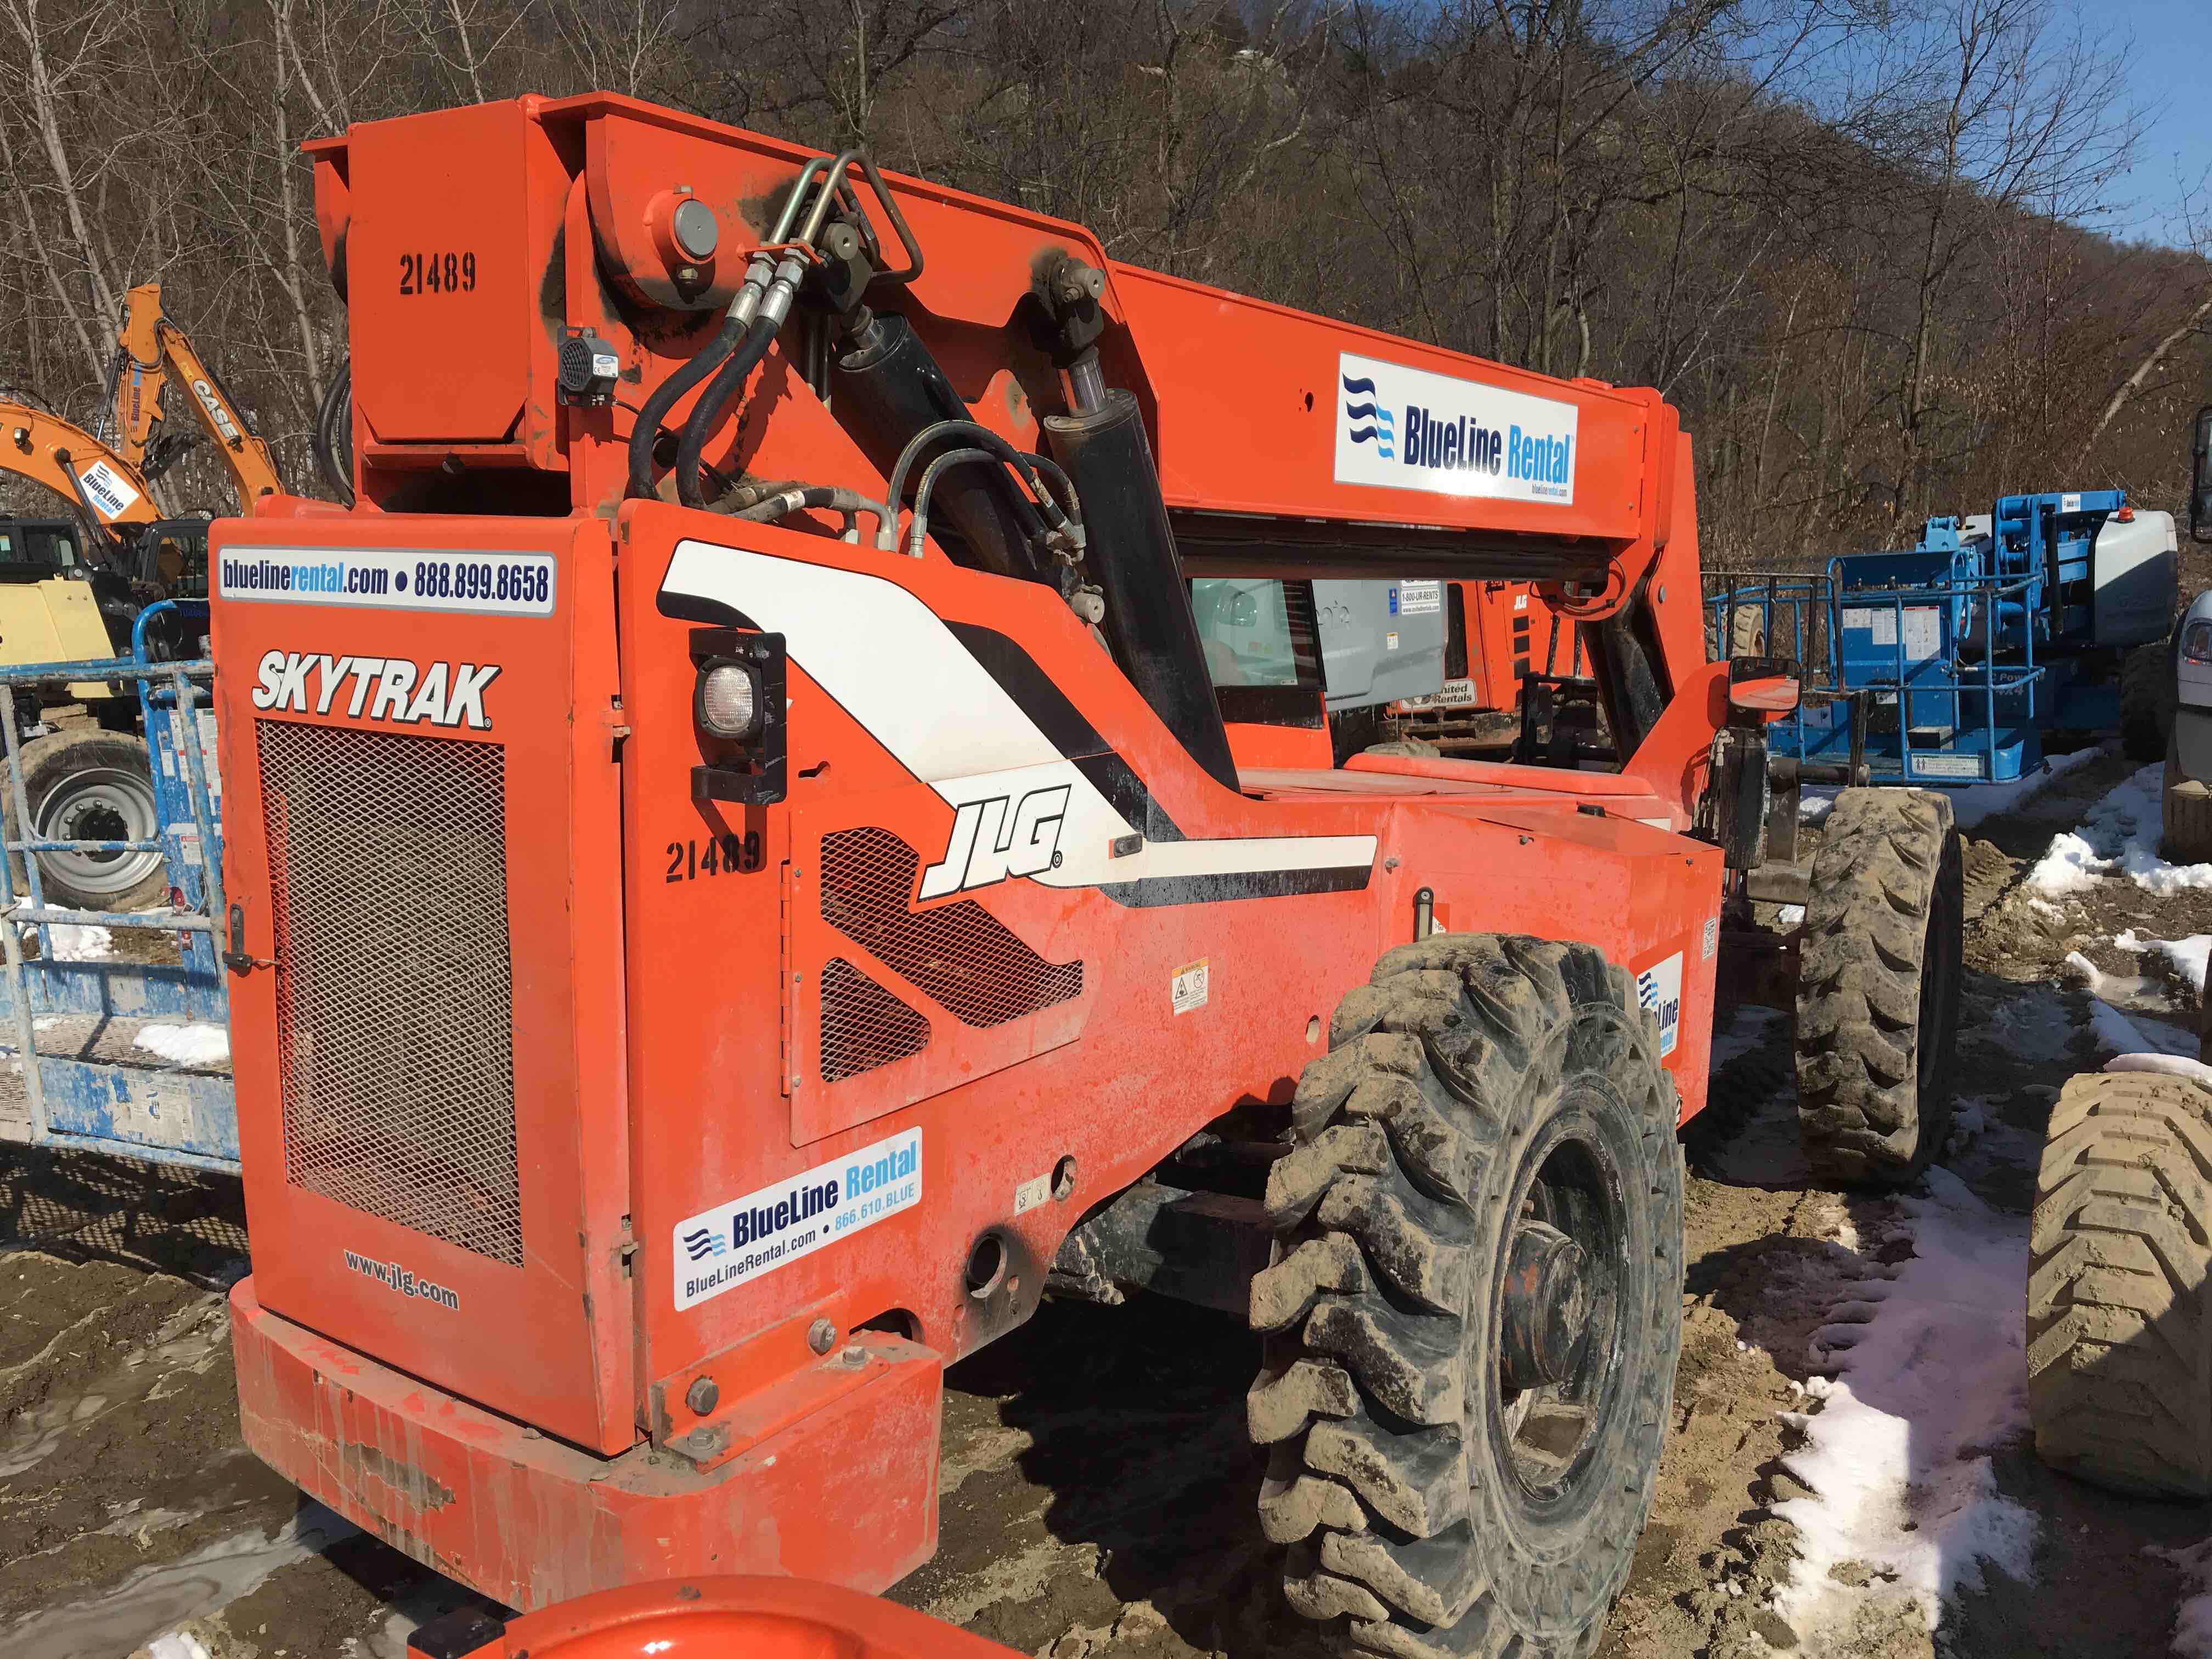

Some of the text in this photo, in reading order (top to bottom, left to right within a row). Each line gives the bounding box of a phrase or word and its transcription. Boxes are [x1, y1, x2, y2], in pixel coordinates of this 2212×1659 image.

[400, 251, 476, 295] 21489
[193, 380, 241, 439] CASE
[1404, 404, 1571, 484] BlueLine Rental
[83, 473, 125, 512] BlueLine
[92, 494, 115, 515] Rental
[223, 559, 549, 602] bluelinerental.com 888.899.8658
[1514, 594, 1527, 610] JLG
[251, 650, 503, 730] SKYTRAK
[1441, 684, 1468, 694] nited
[666, 831, 760, 884] 21489
[917, 783, 1071, 902] JLG
[733, 1141, 916, 1249] BlueLine Rental
[686, 1182, 915, 1297] BlueLineRental.com 866.610.BLUE
[343, 1249, 460, 1312] www.jlg.com
